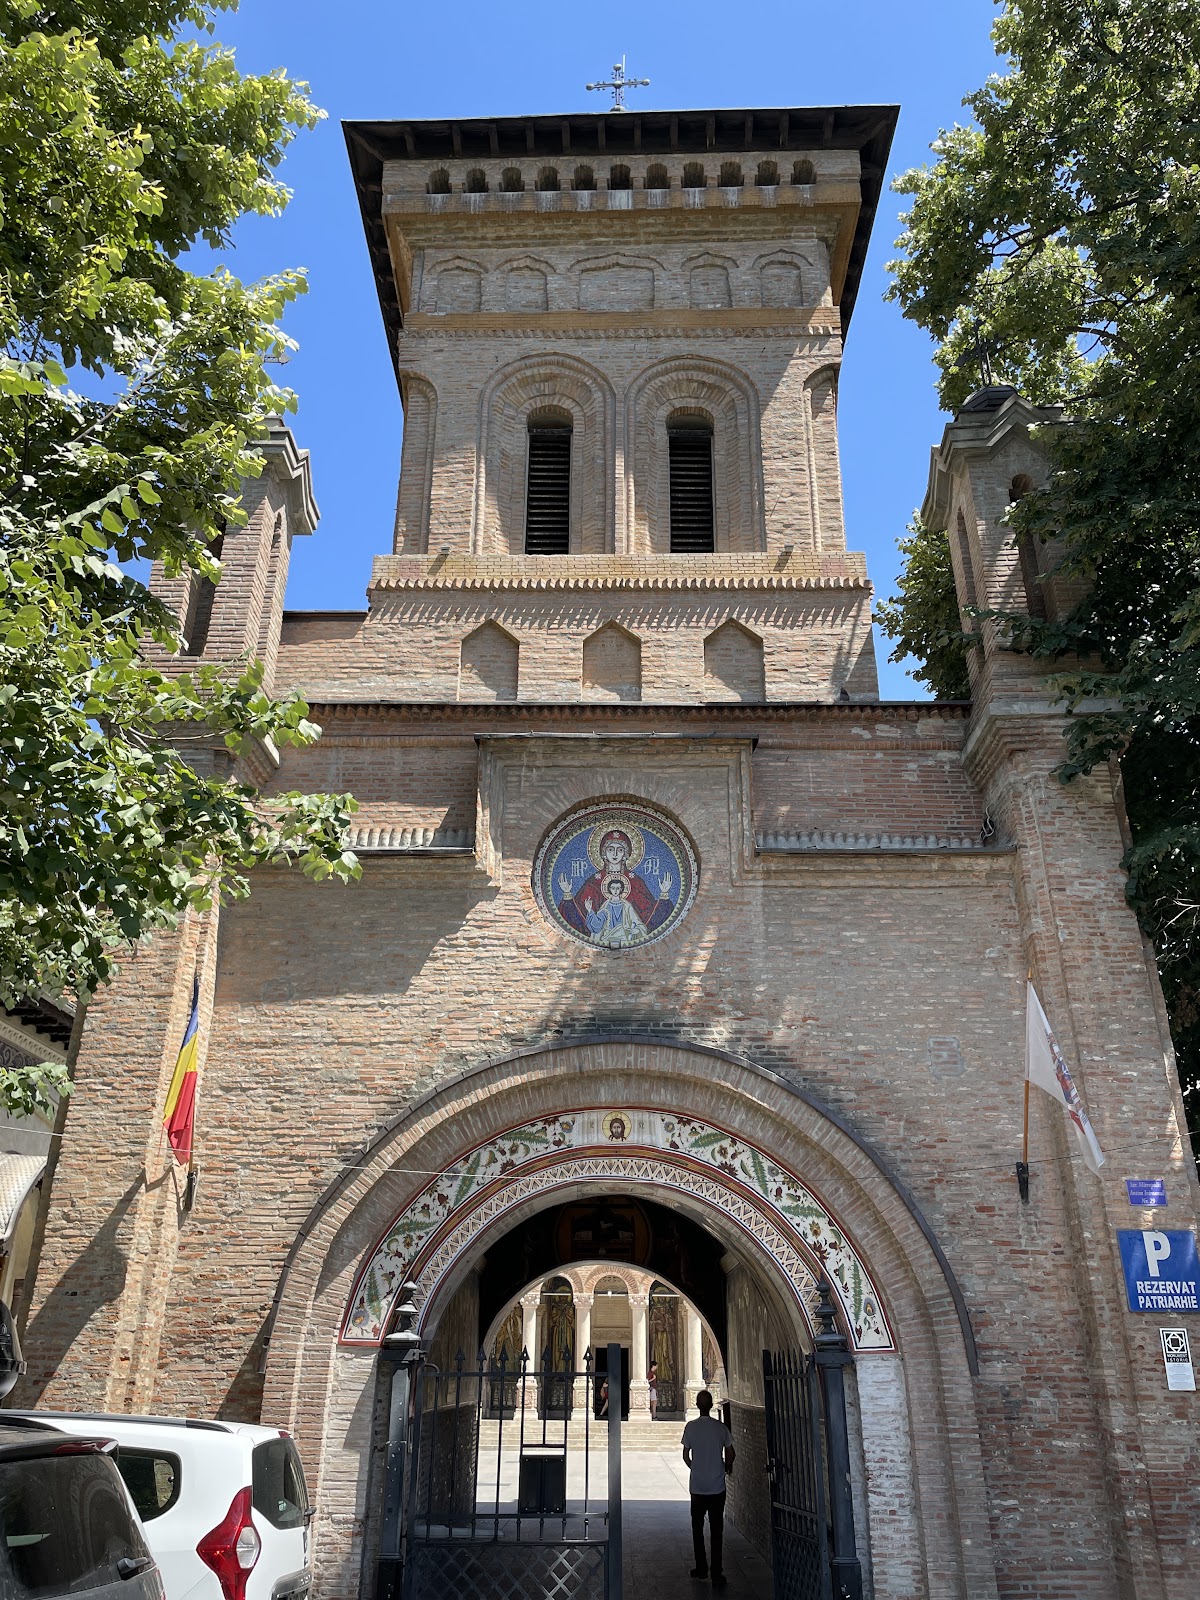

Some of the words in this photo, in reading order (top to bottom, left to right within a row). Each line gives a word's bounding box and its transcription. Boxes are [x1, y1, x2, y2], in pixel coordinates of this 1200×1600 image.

[1142, 1231, 1171, 1277] P
[1136, 1281, 1196, 1294] REZERVAT
[1138, 1295, 1199, 1309] PATRIARHIE
